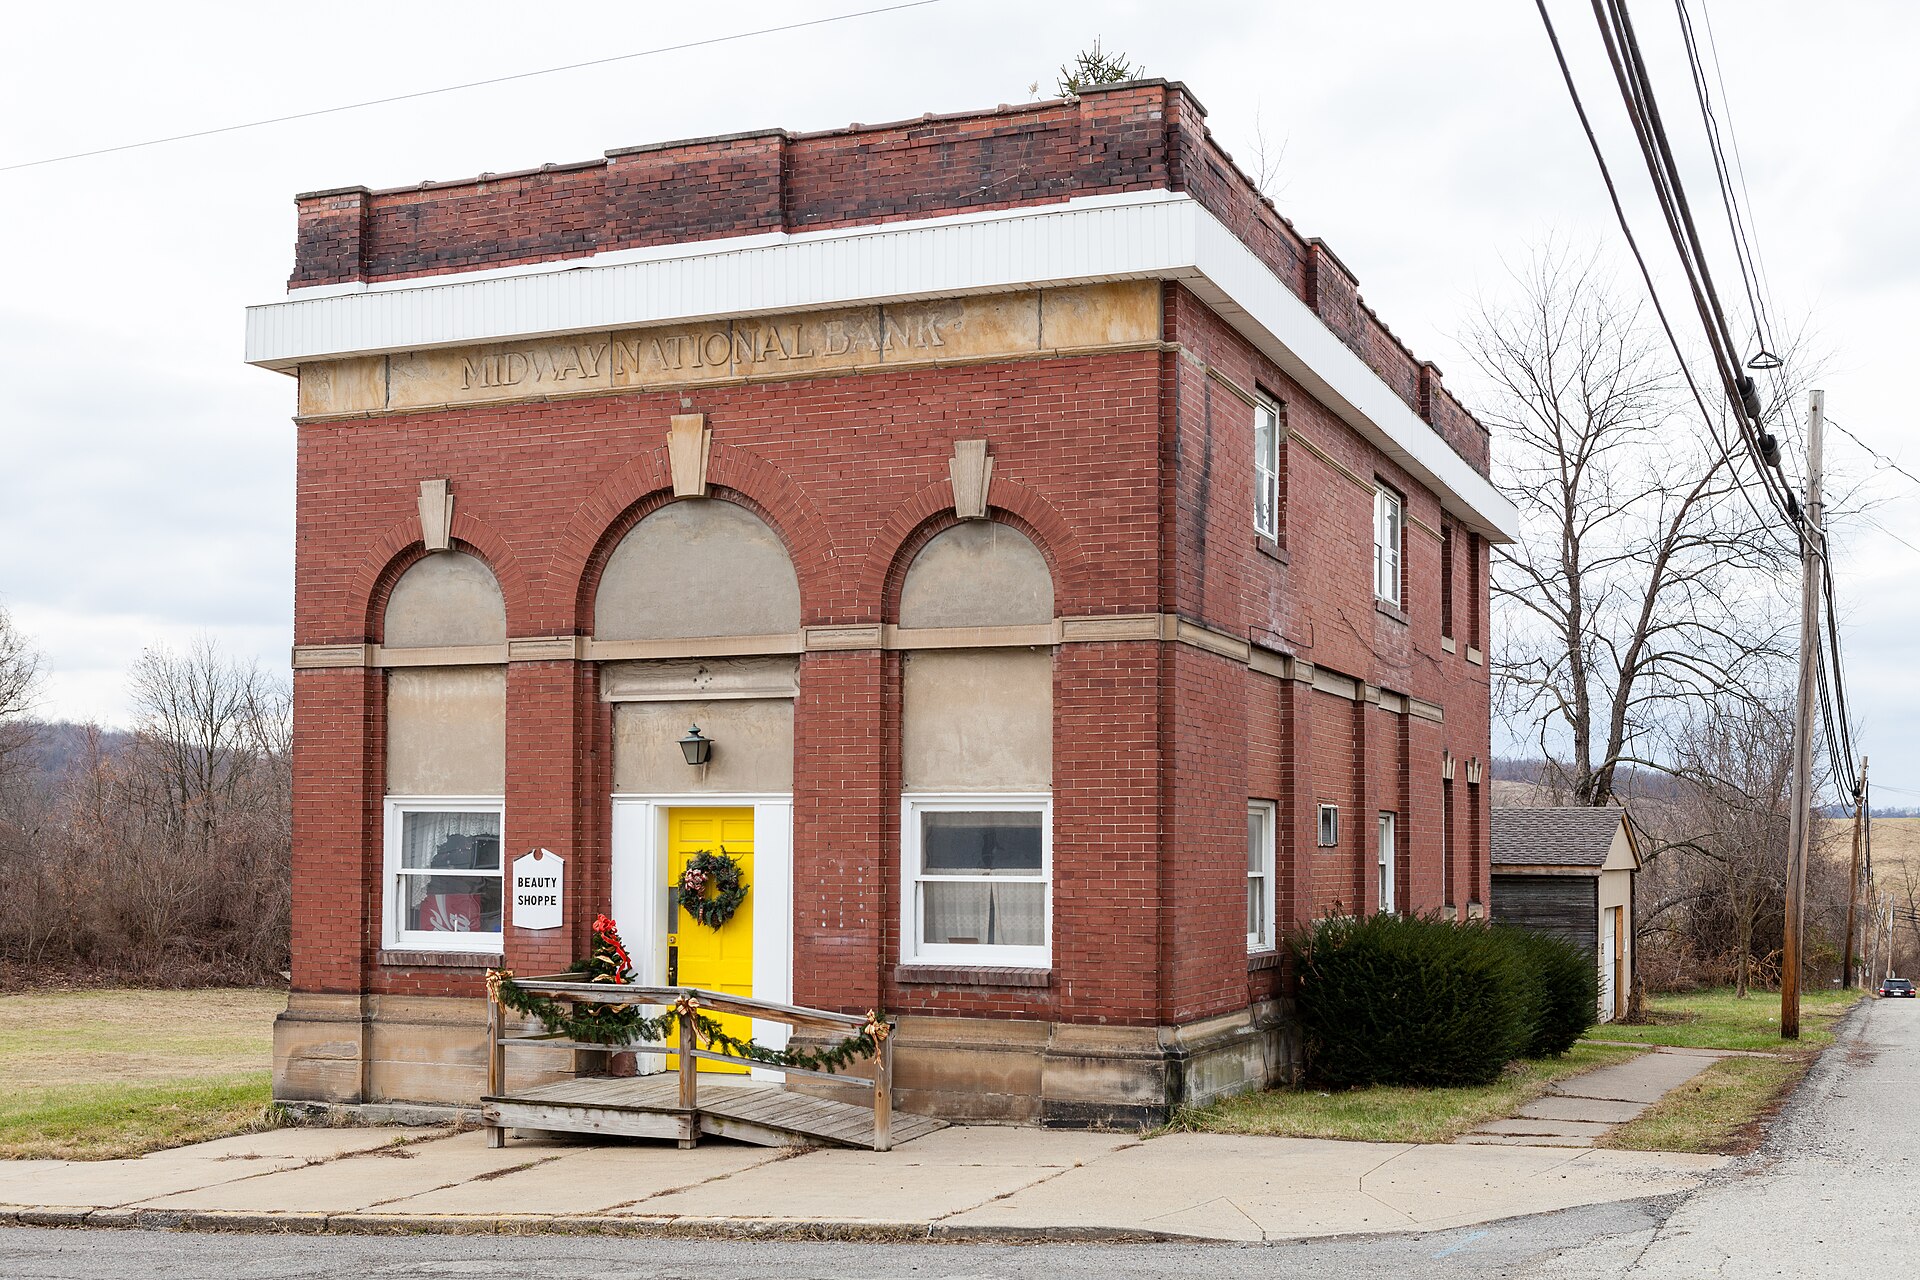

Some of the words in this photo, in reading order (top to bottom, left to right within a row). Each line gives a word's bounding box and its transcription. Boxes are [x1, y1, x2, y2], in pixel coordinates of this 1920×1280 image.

[460, 342, 607, 390] MIDWAY
[615, 323, 814, 376] NATIONAL
[822, 312, 945, 357] BANK
[517, 877, 557, 888] BEAUTY
[517, 895, 557, 906] SHOPPE
